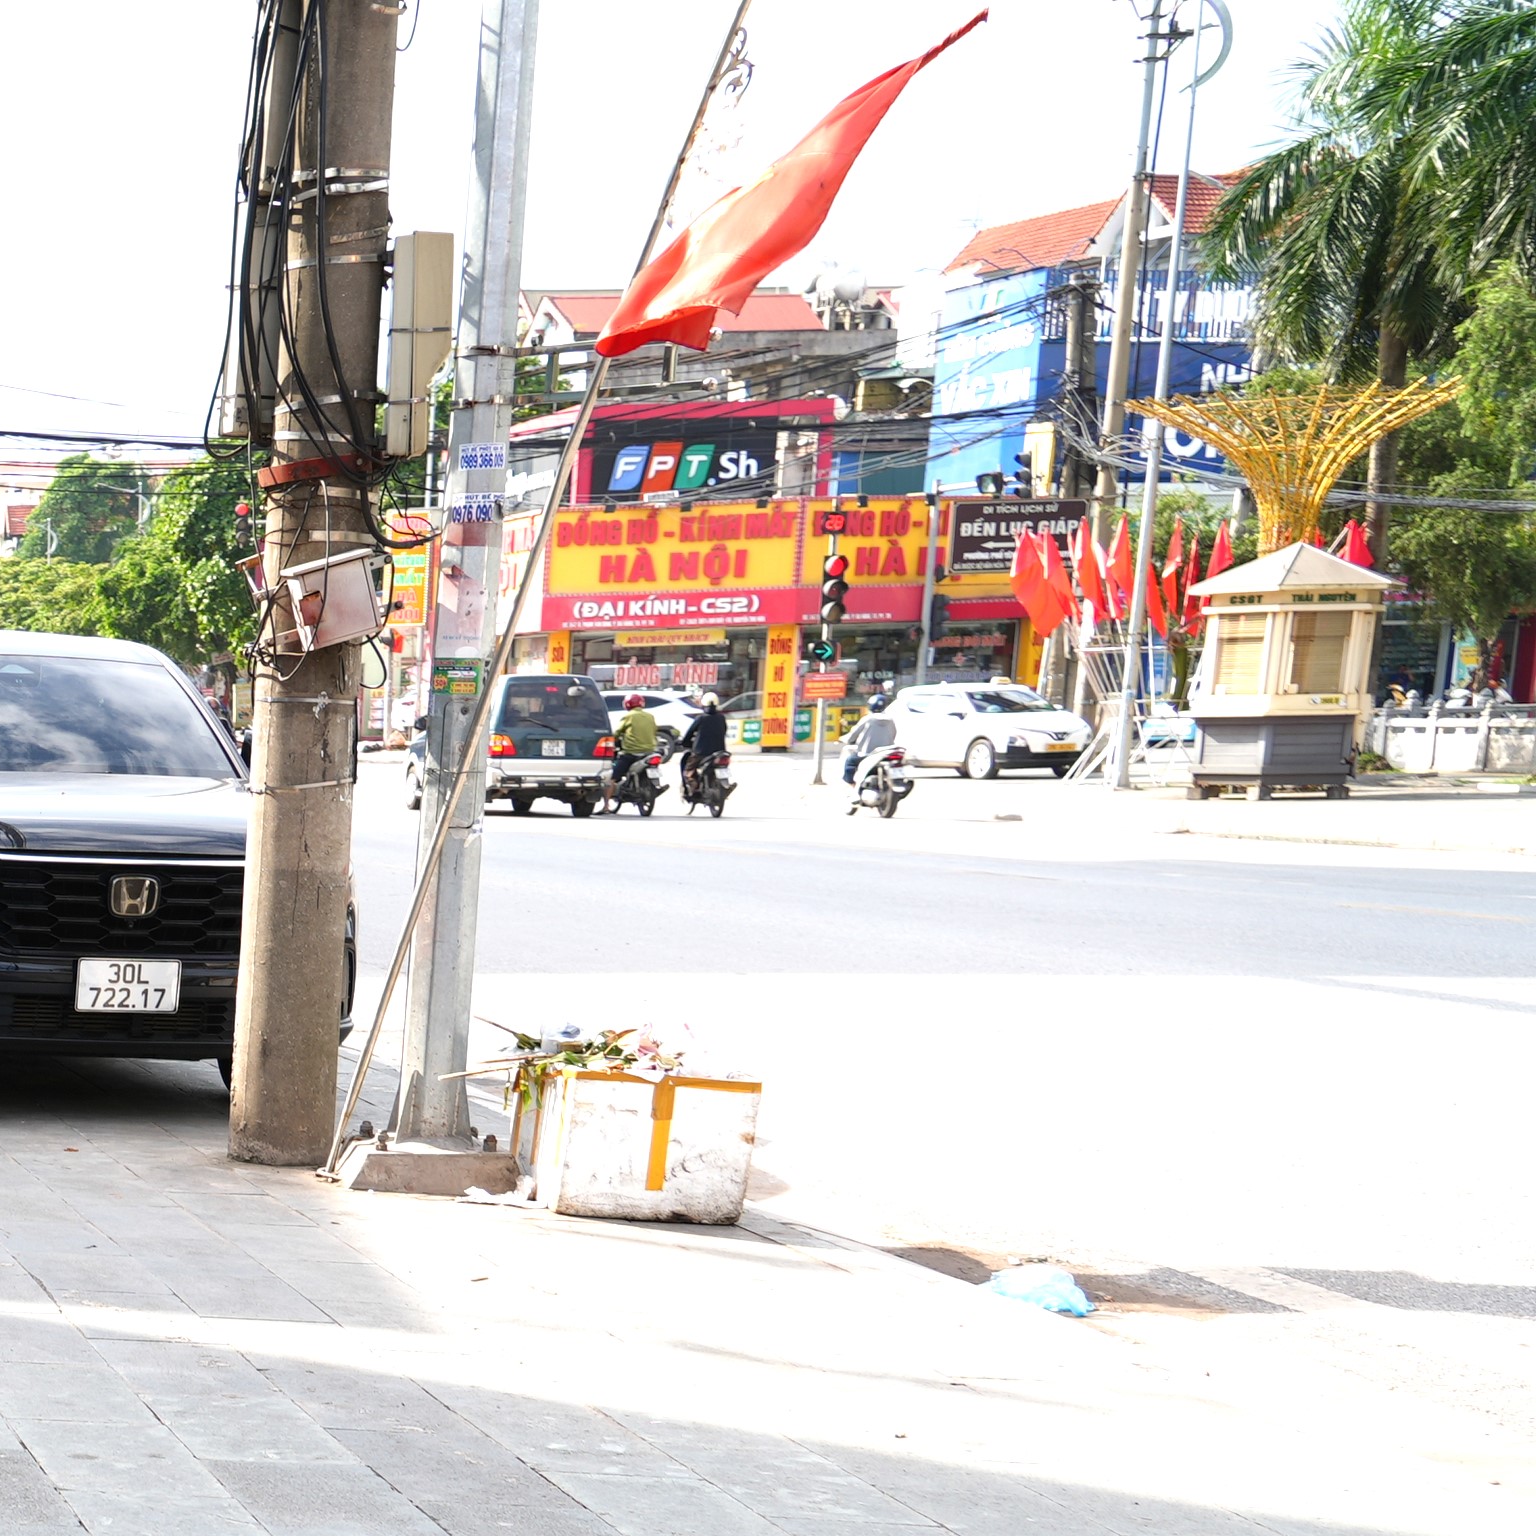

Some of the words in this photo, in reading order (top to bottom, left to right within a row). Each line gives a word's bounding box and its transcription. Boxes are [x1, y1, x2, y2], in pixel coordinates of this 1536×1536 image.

[680, 510, 743, 542] KÍNH
[745, 502, 797, 538] MẮT
[960, 516, 997, 537] ĐỀN
[599, 547, 657, 583] HÀ
[669, 543, 748, 585] NỘI
[855, 539, 907, 576] HÀ
[572, 600, 624, 620] (ĐẠI
[672, 656, 718, 686] KÍNH
[108, 963, 149, 984] 30L
[89, 987, 166, 1009] 722.17
